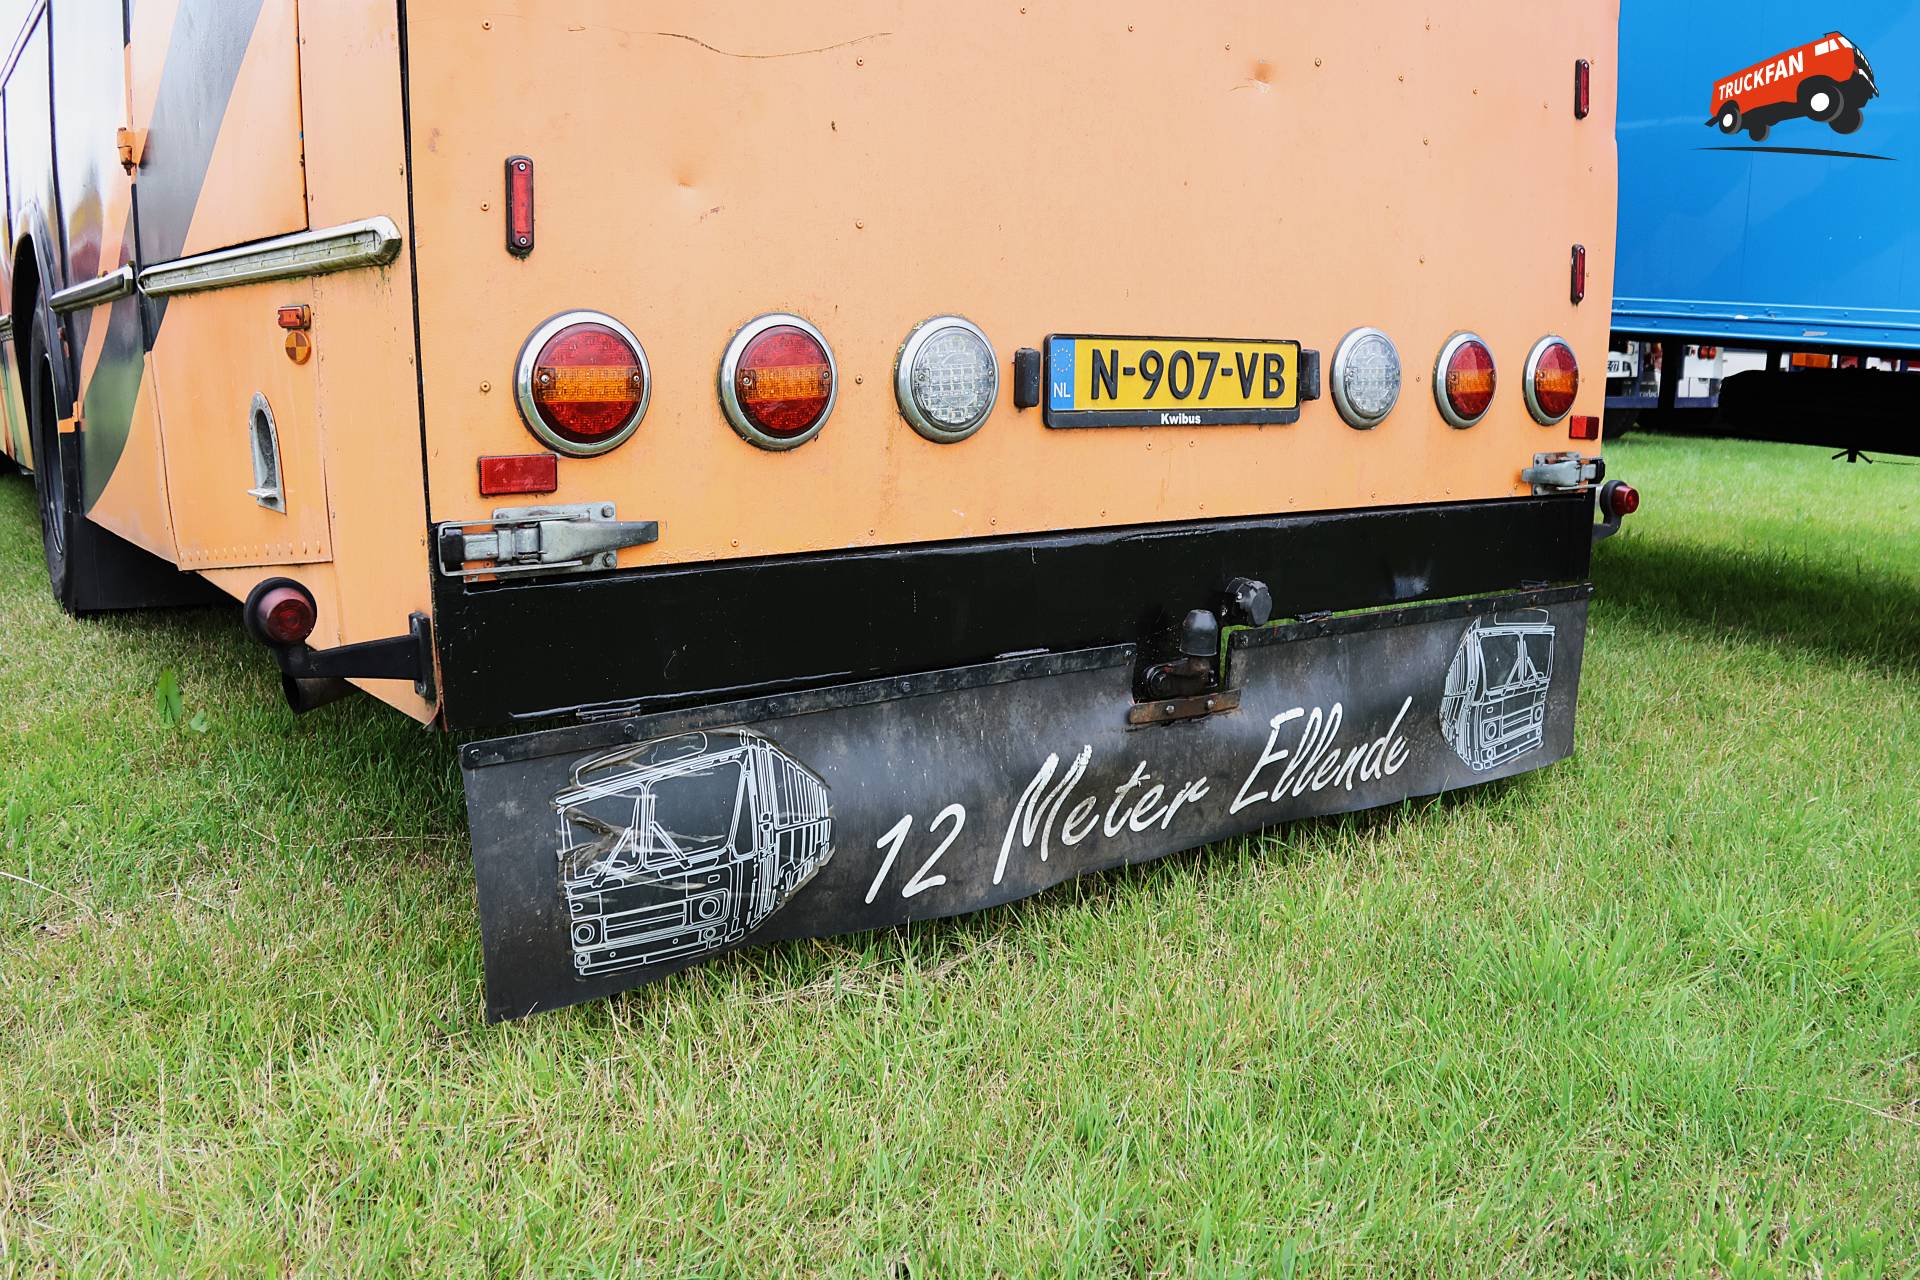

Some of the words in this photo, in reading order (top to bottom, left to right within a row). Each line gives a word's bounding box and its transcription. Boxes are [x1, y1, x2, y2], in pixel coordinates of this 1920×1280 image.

[1053, 382, 1071, 398] NL
[1091, 349, 1285, 400] N-907-VB
[1160, 413, 1201, 425] Kwibus
[865, 803, 967, 904] 12
[992, 744, 1208, 886] Meter
[1229, 695, 1413, 816] Ellende
